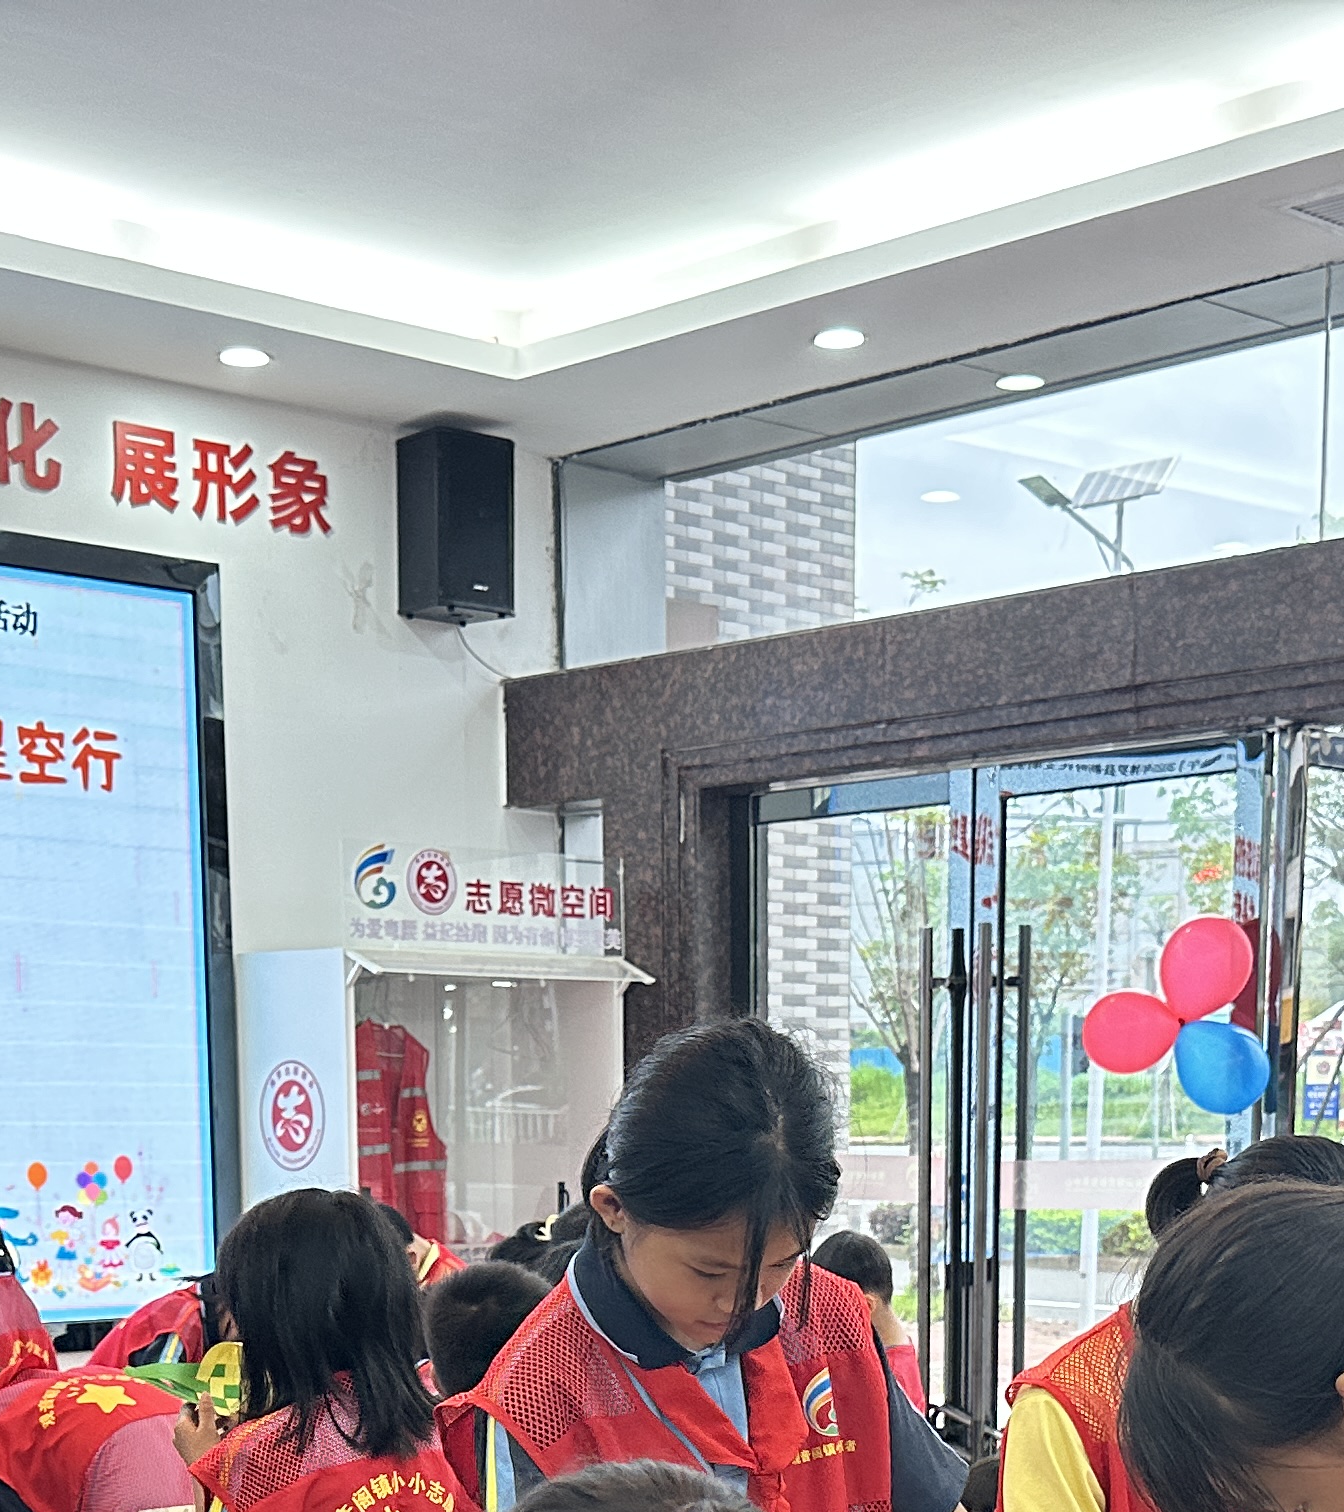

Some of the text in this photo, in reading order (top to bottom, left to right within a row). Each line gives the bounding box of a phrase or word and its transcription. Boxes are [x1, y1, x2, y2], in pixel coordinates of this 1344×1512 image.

[111, 419, 334, 535] 展形象
[465, 879, 613, 921] 志愿微空间
